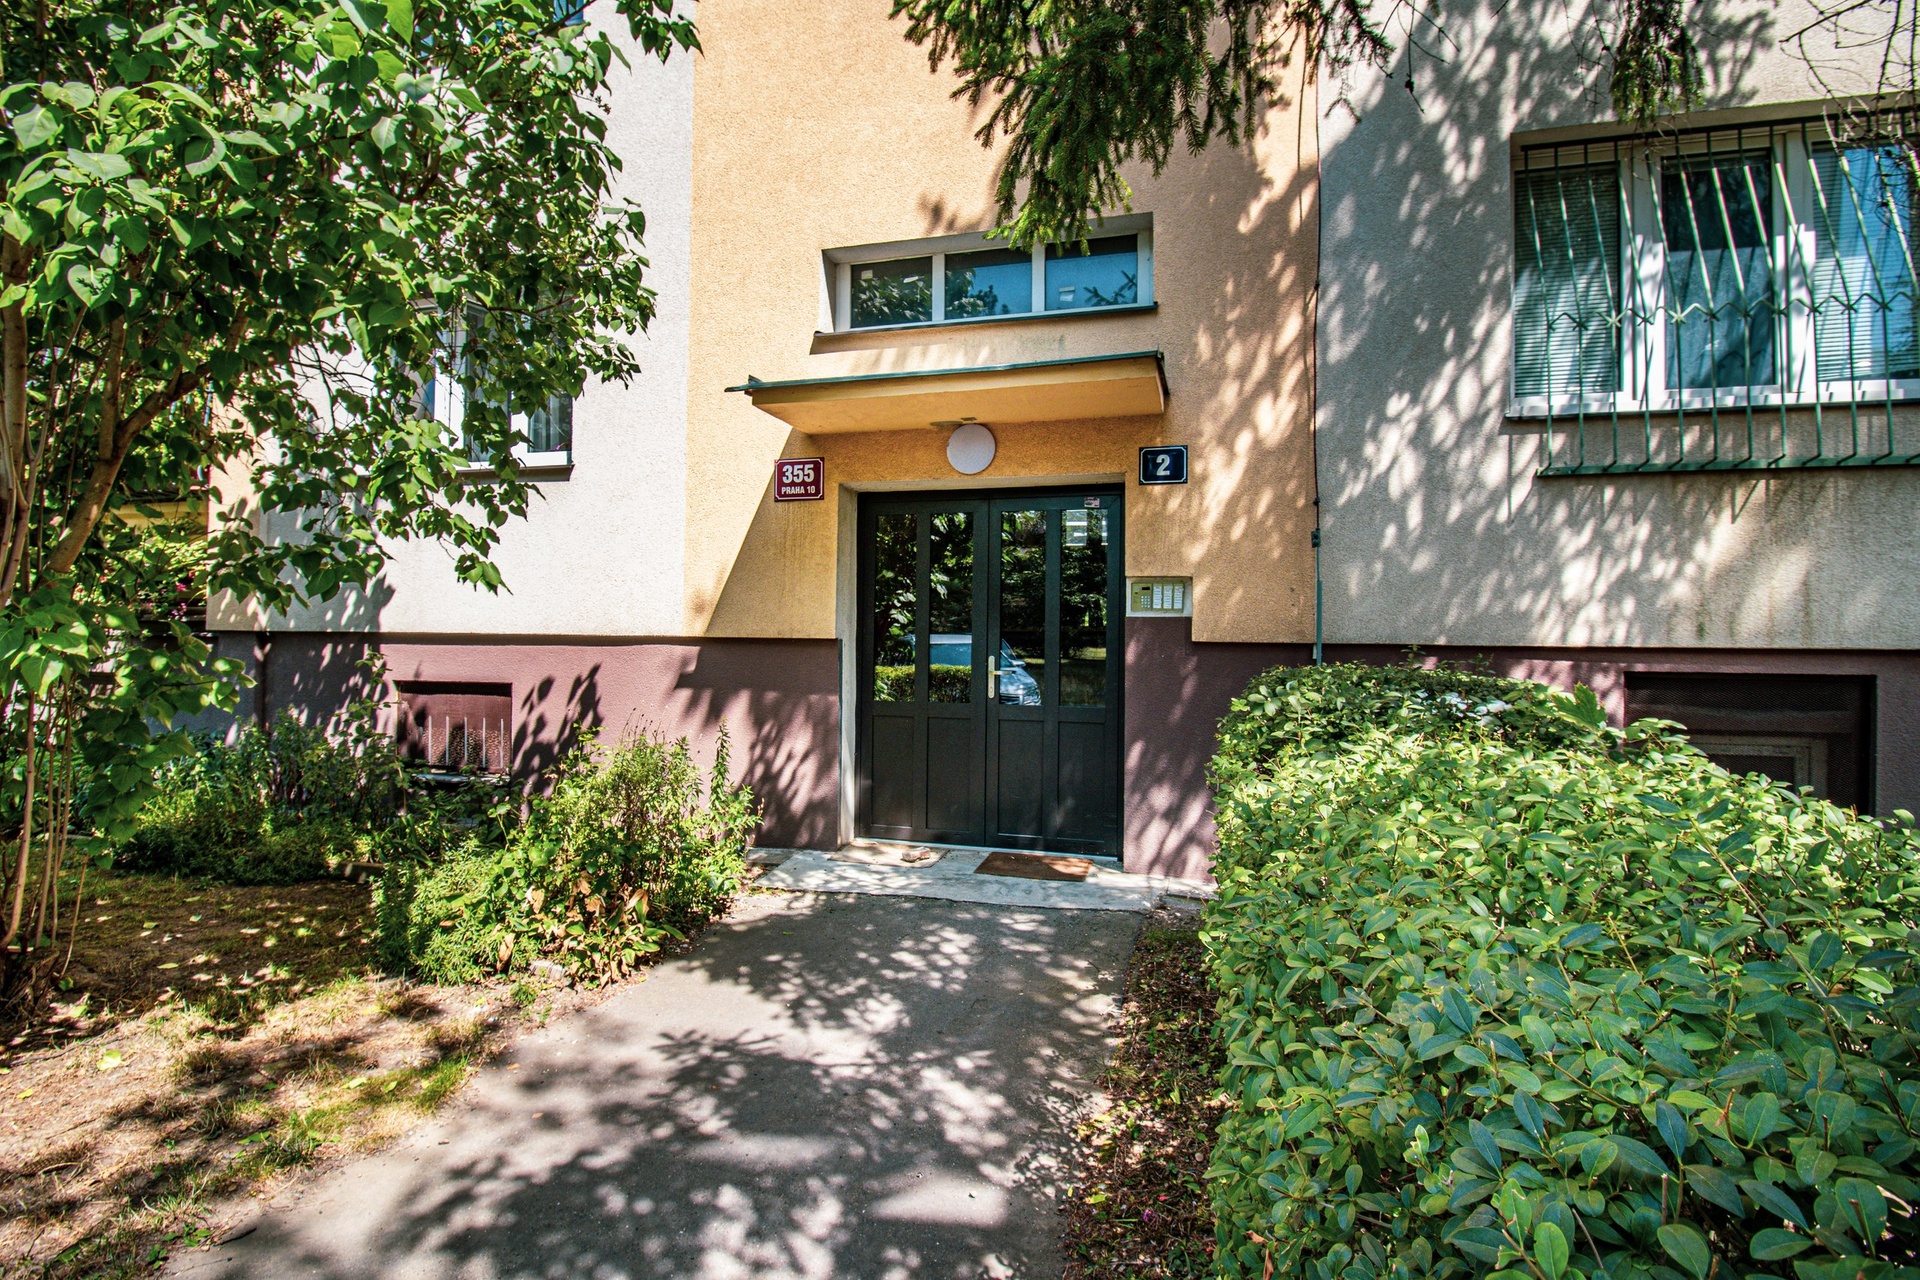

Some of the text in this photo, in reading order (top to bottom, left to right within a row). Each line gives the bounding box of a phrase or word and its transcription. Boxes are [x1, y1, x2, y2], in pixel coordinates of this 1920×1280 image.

[782, 464, 815, 484] 355
[1156, 454, 1170, 476] 2
[781, 485, 816, 495] PRAHA 10
